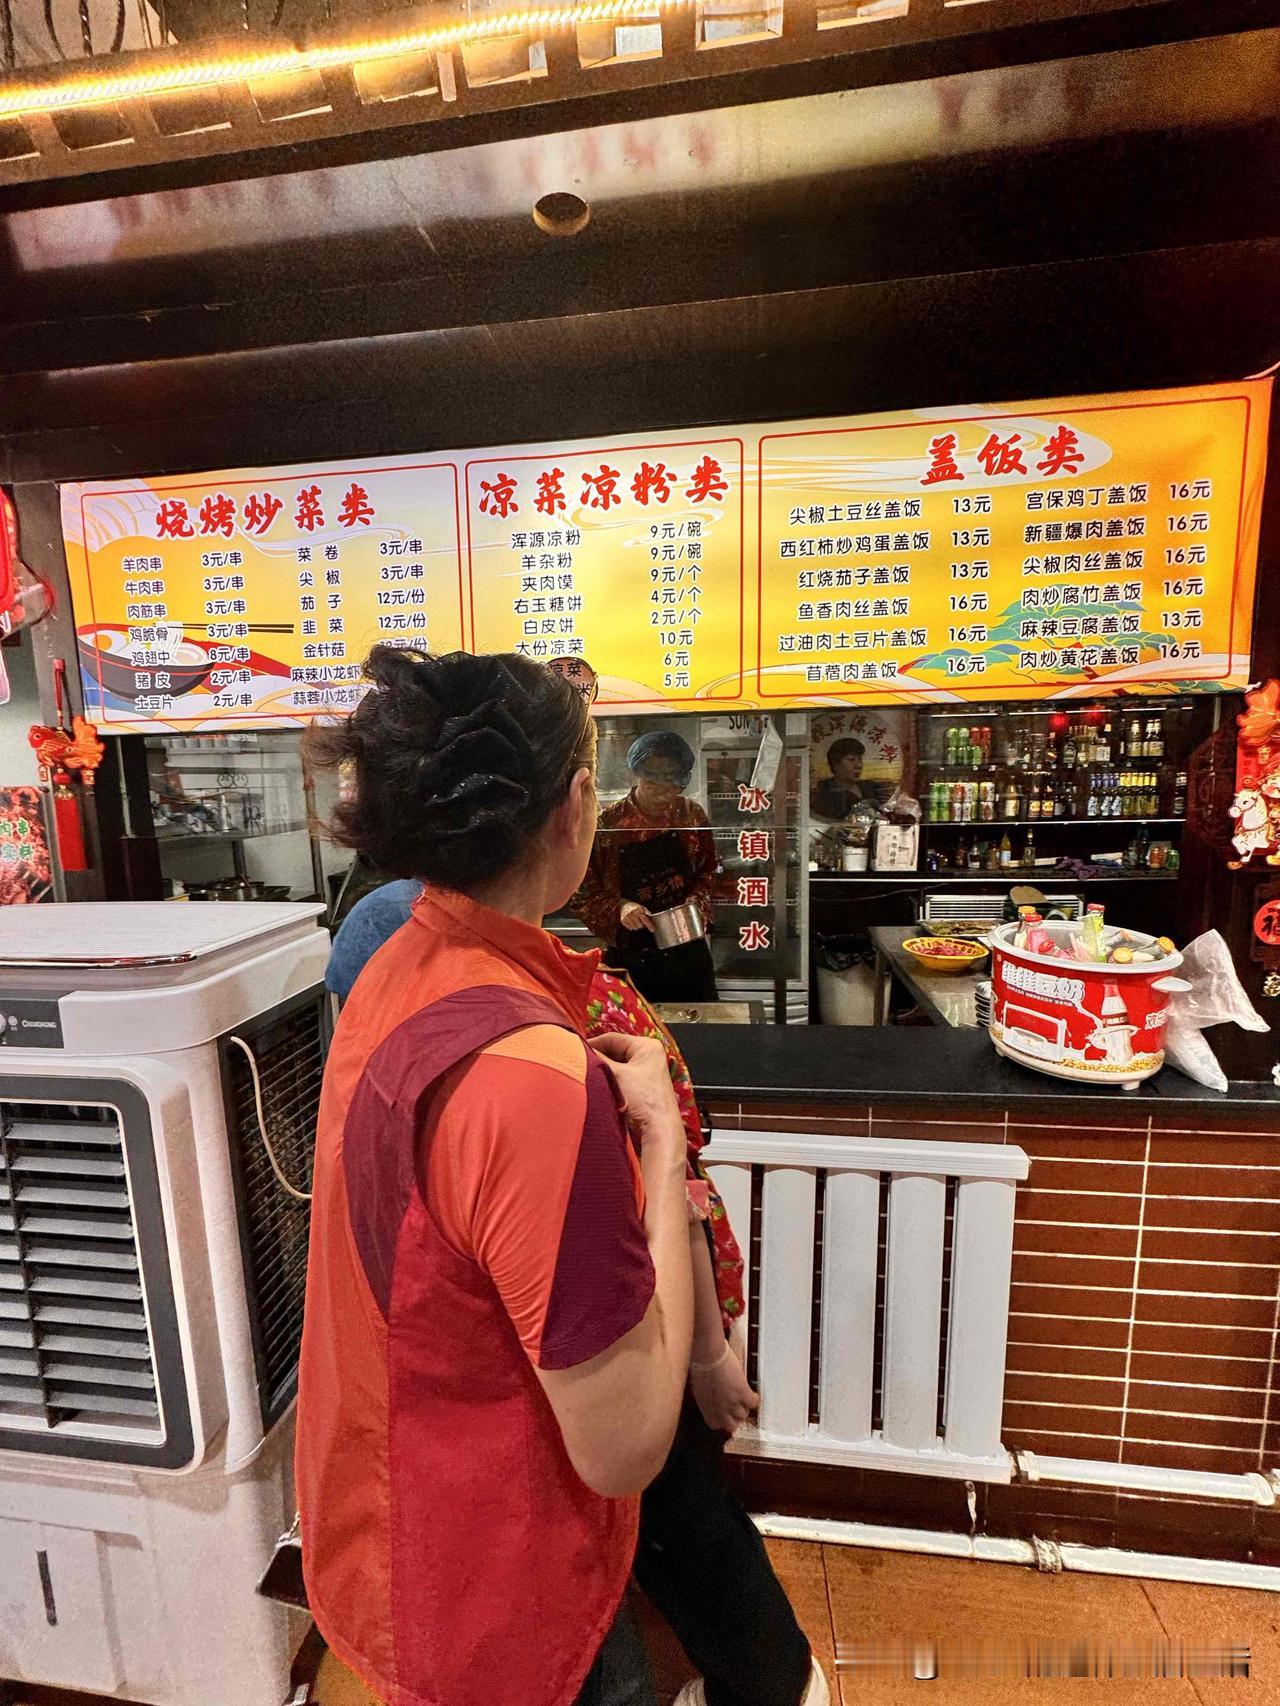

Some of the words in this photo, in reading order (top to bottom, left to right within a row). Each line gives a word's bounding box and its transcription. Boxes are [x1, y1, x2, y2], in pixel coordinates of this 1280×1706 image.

[920, 425, 1085, 486] 盖饭类
[479, 455, 728, 518] 凉菜凉粉类
[1026, 484, 1148, 511] 宫保鸡丁盖饭
[1170, 481, 1211, 500] 16元
[155, 482, 376, 539] 烧烤炒菜类
[790, 499, 921, 524] 尖椒土豆丝盖饭
[952, 496, 992, 514] 13元
[512, 530, 581, 549] 浑源凉粉
[650, 521, 702, 538] 9元/碗
[1025, 518, 1146, 543] 新疆爆肉盖饭
[1167, 514, 1208, 533] 16元
[298, 545, 339, 562] 菜卷
[380, 539, 423, 555] 3元/串
[522, 552, 572, 569] 羊杂粉
[651, 543, 702, 560] 9元/碗
[781, 531, 930, 558] 西红柿炒鸡蛋盖饭
[952, 529, 990, 547] 13元
[123, 557, 162, 573] 羊肉串
[202, 552, 242, 568] 3元/串
[1024, 550, 1144, 575] 尖椒肉丝盖饭
[1165, 546, 1206, 565] 16元
[125, 580, 164, 596] 牛肉串
[204, 576, 244, 592] 3元/串
[299, 570, 341, 587] 尖椒
[381, 564, 424, 580] 3元/串
[522, 575, 573, 592] 夹肉馍
[652, 565, 702, 582] 9元/个
[798, 566, 910, 588] 红烧茄子盖饭
[950, 561, 989, 580] 13元
[301, 594, 342, 610] 茄子
[377, 589, 425, 604] 12元/份
[515, 596, 582, 613] 右玉糖饼
[652, 587, 701, 603] 4元/个
[1022, 583, 1142, 607] 肉炒腐竹盖饭
[1164, 578, 1204, 597] 16元
[127, 604, 166, 619] 肉筋串
[206, 600, 246, 615] 3元/串
[798, 599, 909, 621] 鱼香肉丝盖饭
[950, 594, 988, 611] 16元
[130, 627, 168, 642] 鸡脆骨
[208, 624, 248, 638] 3元/串
[303, 619, 344, 634] 韭菜
[378, 614, 426, 629] 12元/份
[524, 618, 574, 634] 白皮饼
[652, 609, 701, 625] 2元/个
[1020, 615, 1140, 638] 麻辣豆腐盖饭
[1162, 610, 1202, 628] 13元
[304, 642, 345, 657] 金针菇
[516, 639, 584, 655] 大份凉菜
[660, 630, 693, 645] 10元
[779, 629, 927, 652] 过油肉土豆片盖饭
[948, 625, 987, 643] 16元
[132, 650, 170, 665] 鸡翅中
[210, 647, 250, 662] 8元/串
[665, 651, 689, 666] 6元
[1020, 647, 1139, 669] 肉炒黄花盖饭
[1160, 642, 1200, 660] 16元
[136, 673, 170, 689] 猪皮
[211, 670, 251, 685] 2元/串
[665, 672, 689, 688] 5元
[806, 662, 897, 682] 苜蓿肉盖饭
[947, 656, 986, 674] 16元
[136, 695, 174, 710] 土豆片
[213, 693, 253, 708] 2元/串
[737, 783, 770, 950] 冰镇酒水
